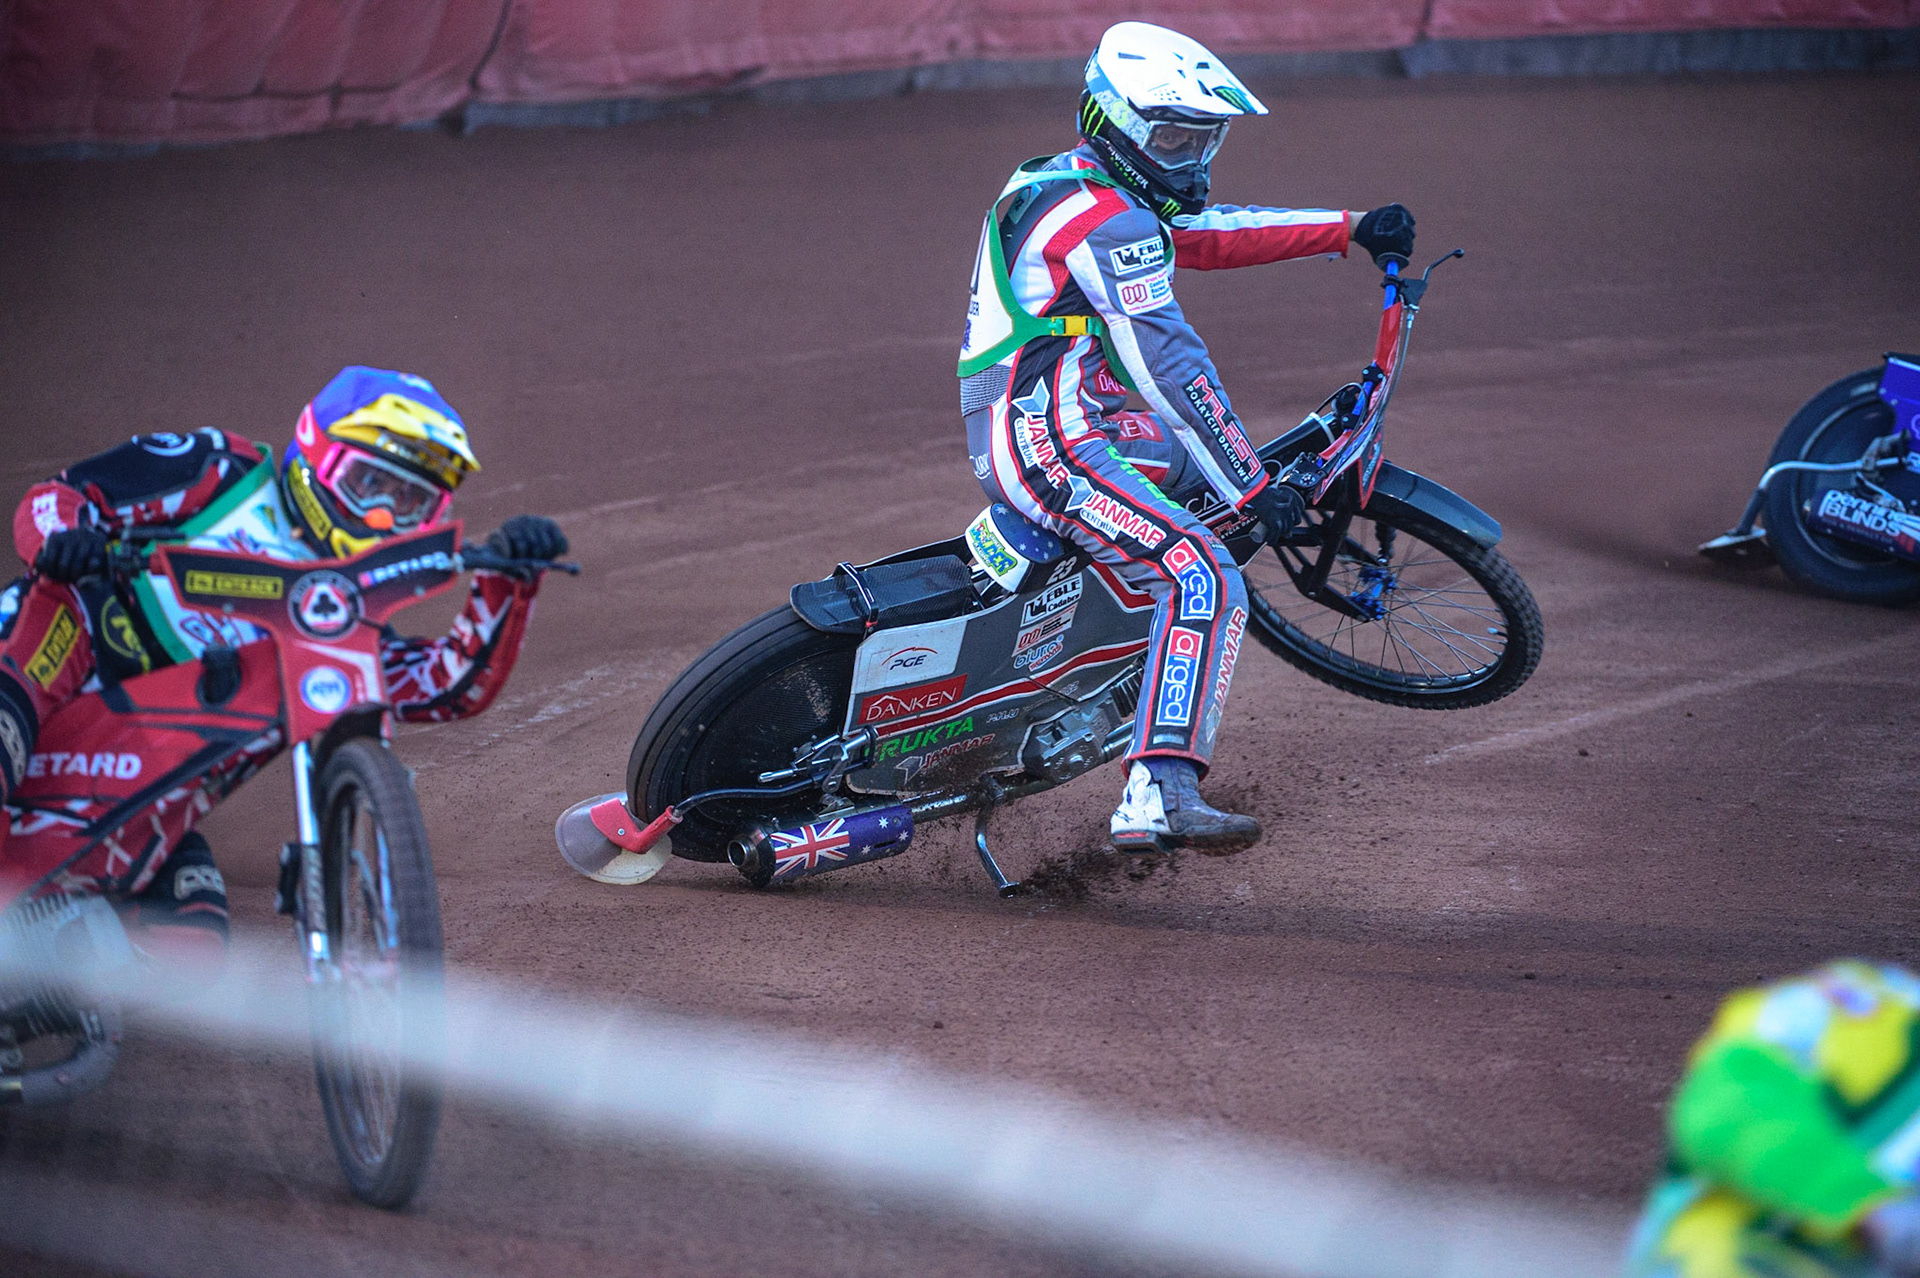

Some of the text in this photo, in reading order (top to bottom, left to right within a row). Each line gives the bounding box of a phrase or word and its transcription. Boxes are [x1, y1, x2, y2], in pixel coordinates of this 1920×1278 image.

[1016, 418, 1034, 466] CENTRUM
[1027, 413, 1069, 488] JANMAR
[1186, 385, 1251, 483] POKRYCIA DACHOWE
[1081, 509, 1118, 538] CENTRUM
[1086, 493, 1165, 548] JANMAR
[1825, 501, 1901, 537] BLINDS
[1046, 555, 1078, 586] 23
[889, 654, 927, 671] PGE
[1015, 640, 1059, 668] biuro
[1215, 607, 1247, 712] JANMAR
[1164, 633, 1195, 722] arged
[866, 686, 958, 721] DANKEN
[27, 752, 142, 780] ETARD
[921, 734, 996, 769] JANMAR
